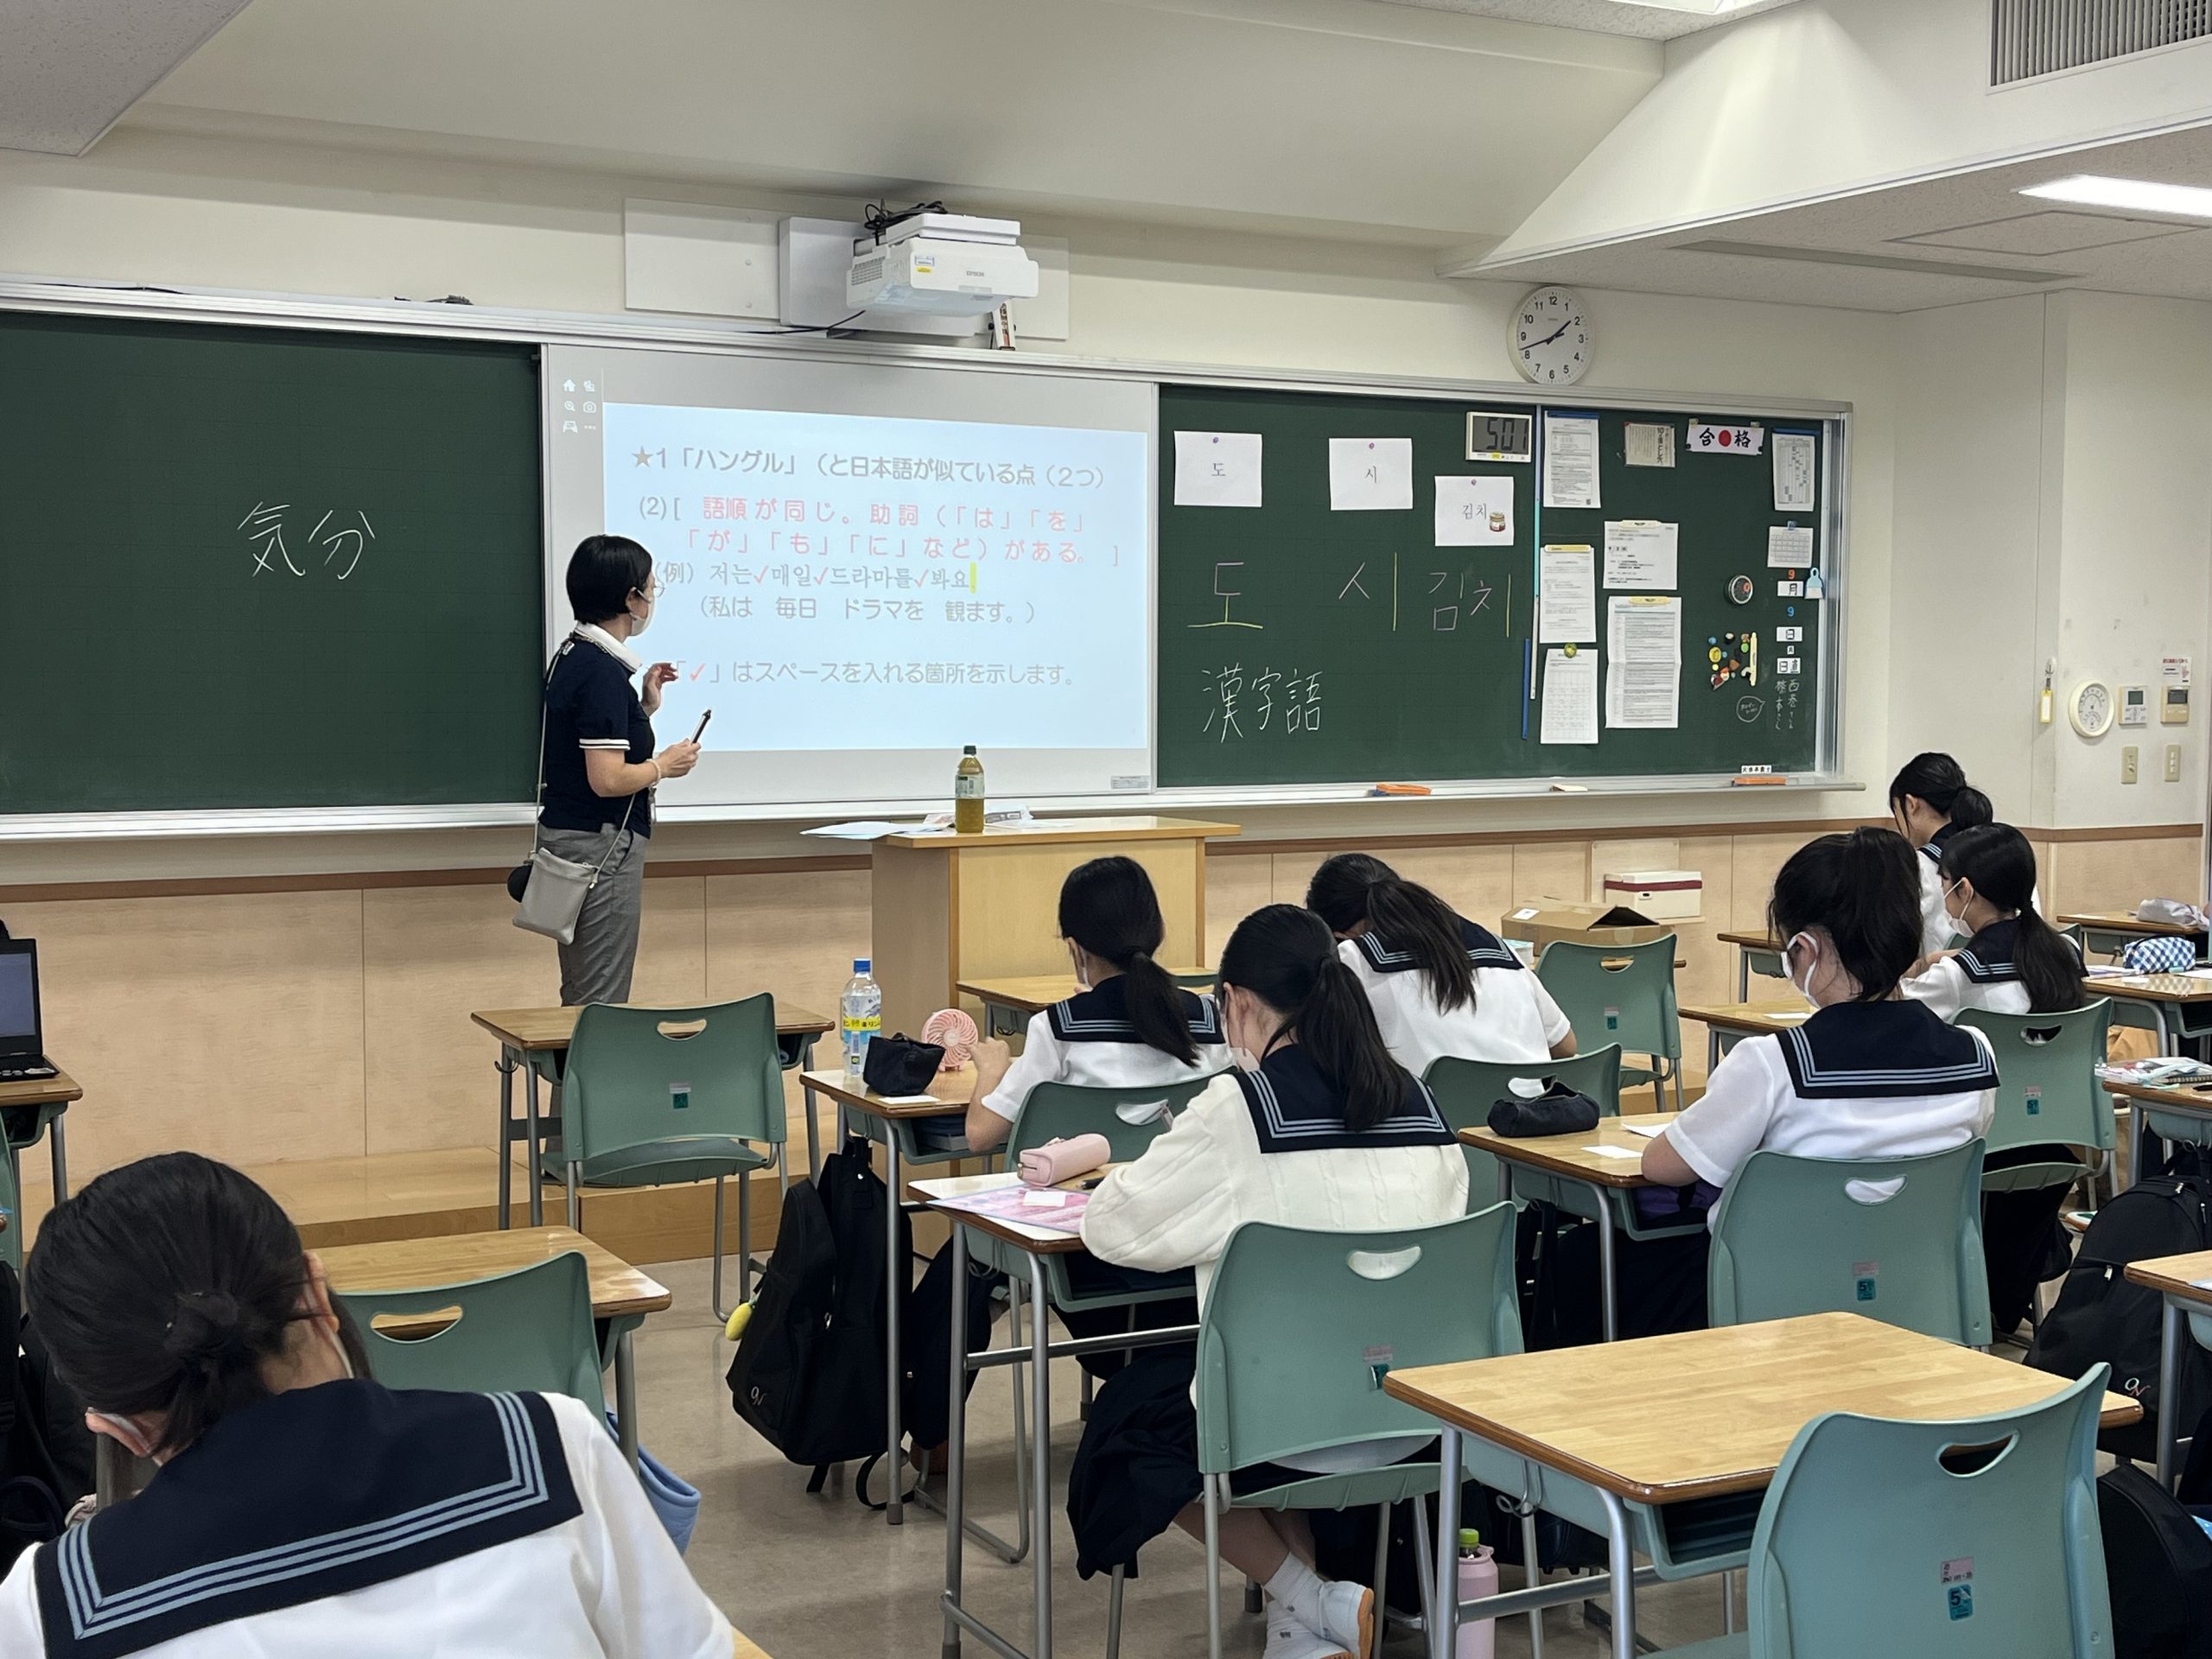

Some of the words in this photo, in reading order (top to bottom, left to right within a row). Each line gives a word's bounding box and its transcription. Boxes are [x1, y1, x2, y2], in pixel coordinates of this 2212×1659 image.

[1535, 302, 1543, 310] 11
[1548, 296, 1558, 305] 12
[1564, 302, 1569, 311] 1
[1524, 315, 1534, 324] 10
[1574, 316, 1580, 326] 2
[1521, 332, 1527, 340] 9
[1578, 334, 1585, 343] 3
[1524, 350, 1530, 359] 8
[1573, 353, 1580, 361] 4
[1535, 364, 1541, 372] 7
[1563, 365, 1569, 373] 5
[1548, 370, 1555, 379] 6
[1699, 427, 1751, 448] 合格
[1211, 462, 1226, 477] 도
[1364, 465, 1377, 484] 시
[1462, 502, 1487, 519] 김치
[238, 501, 375, 580] 気分
[1788, 569, 1796, 580] 9
[1187, 561, 1264, 629] 도
[1338, 551, 1397, 632] 시
[1789, 583, 1797, 596] 月
[775, 596, 817, 619] 毎日
[844, 598, 924, 620] ドラマを
[1429, 573, 1512, 638] 김치
[1787, 606, 1795, 617] 9
[1785, 629, 1796, 639] 日
[1202, 663, 1323, 743] 漢字語
[1950, 1590, 1961, 1606] 5
